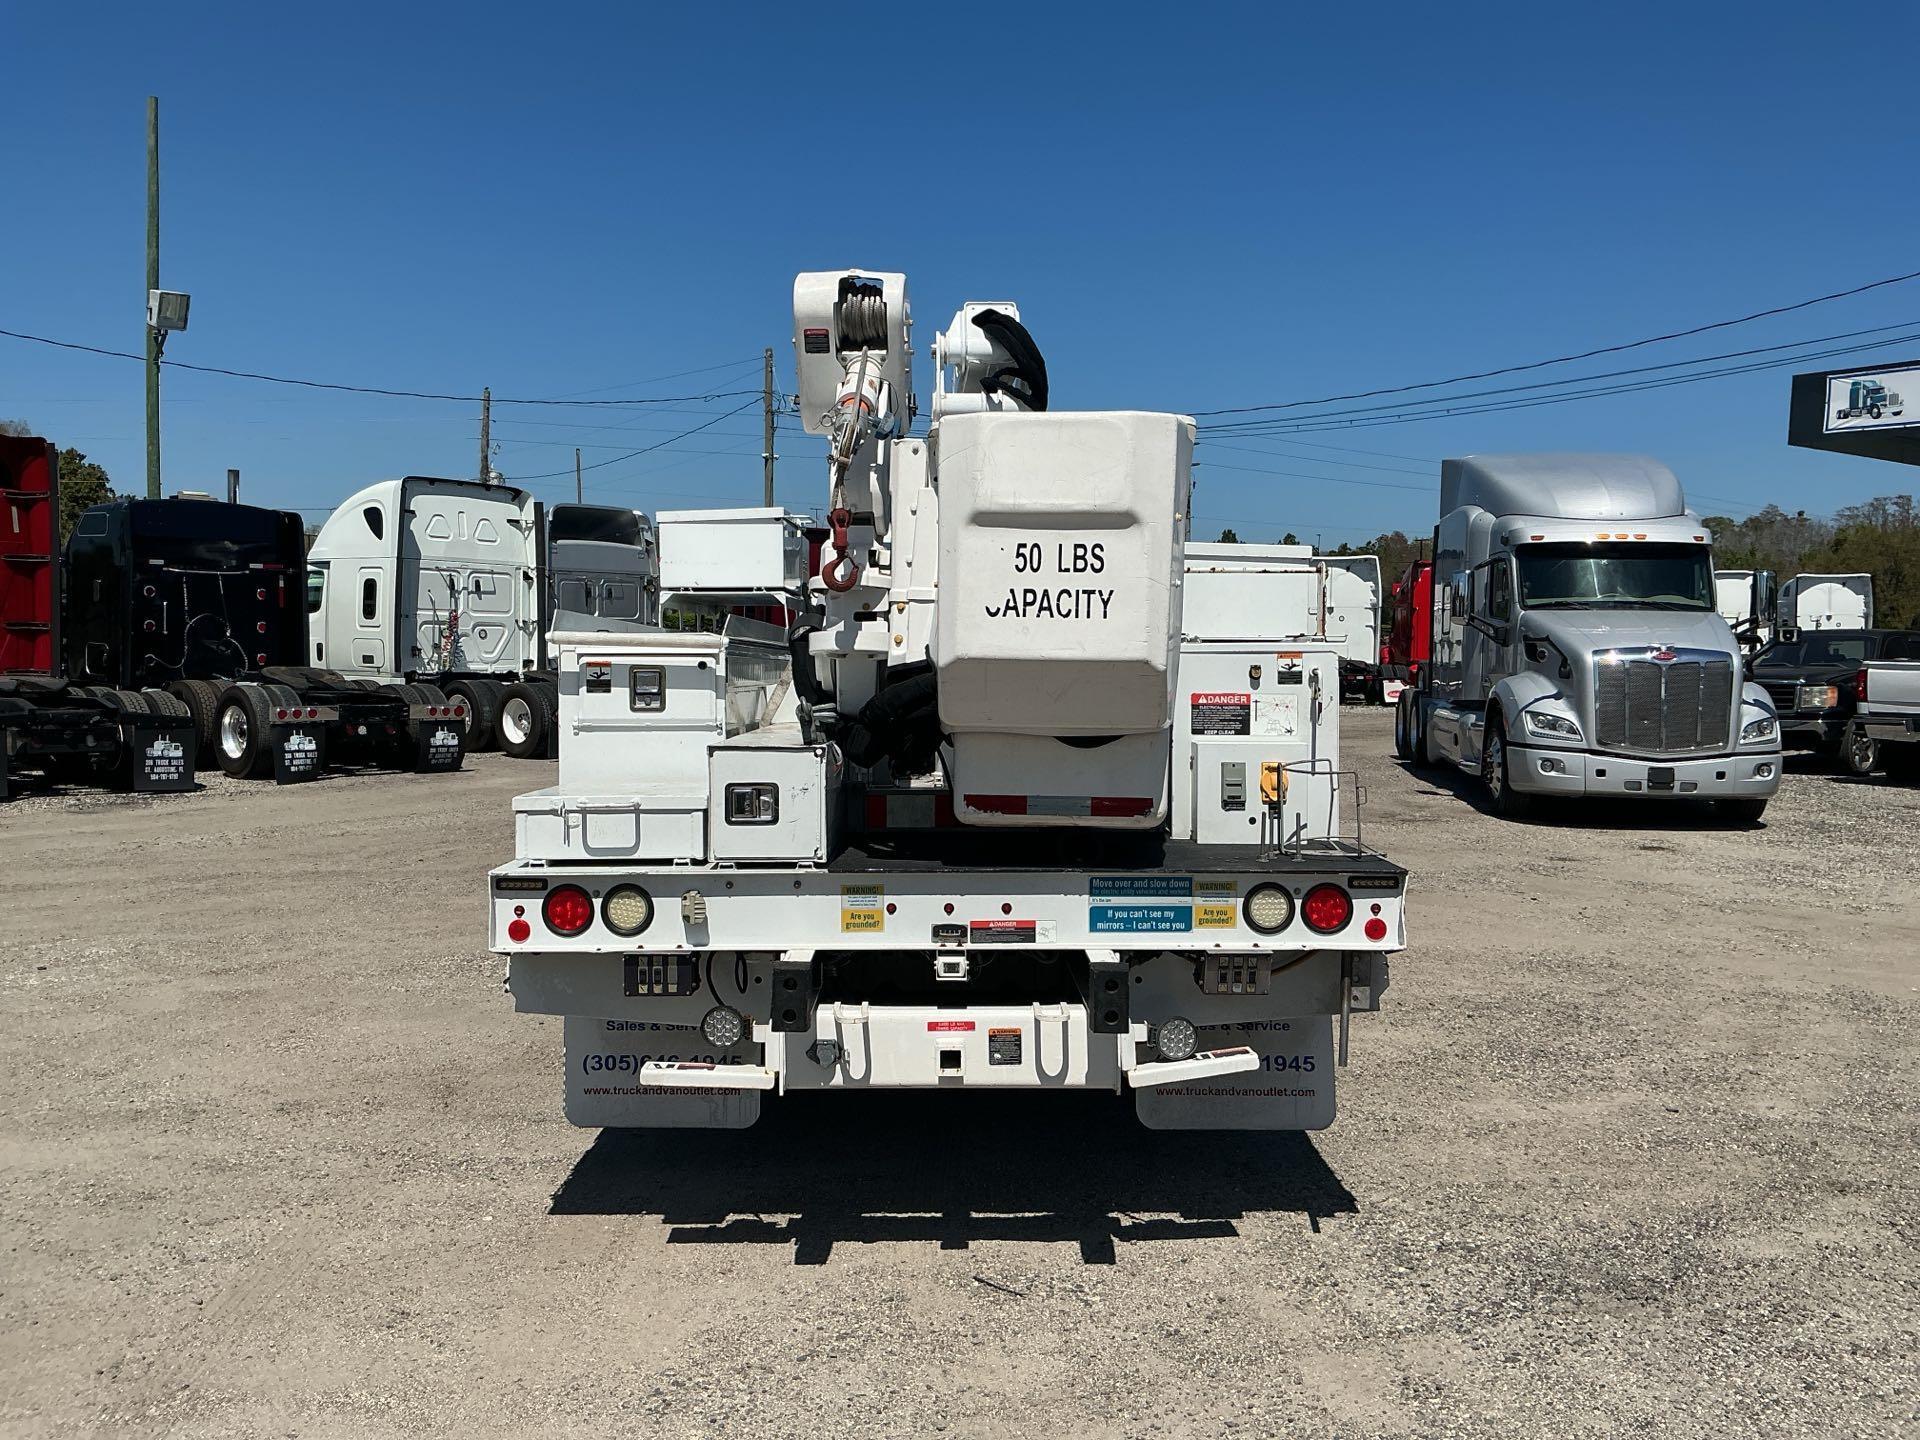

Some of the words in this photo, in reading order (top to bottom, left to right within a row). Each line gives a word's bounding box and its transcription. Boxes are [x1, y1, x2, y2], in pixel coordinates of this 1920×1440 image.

[1058, 543, 1105, 573] LBS
[1207, 695, 1247, 704] DANGER
[1092, 878, 1113, 888] Move
[1114, 879, 1131, 888] over
[1133, 878, 1148, 888] and
[1150, 878, 1168, 888] slow
[1169, 878, 1190, 888] down
[1120, 888, 1135, 896] utility
[850, 912, 862, 920] Are
[863, 913, 875, 921] you
[1107, 909, 1113, 917] If
[1114, 911, 1128, 919] you
[1129, 909, 1148, 917] can't
[1163, 911, 1175, 919] my
[845, 920, 880, 930] grounded?
[1097, 921, 1124, 929] mirrors
[1137, 921, 1156, 929] can't
[1171, 922, 1185, 930] you
[1198, 916, 1233, 925] grounded?
[606, 1020, 646, 1031] Sales
[650, 1022, 661, 1031] &
[1236, 1020, 1290, 1031] Service
[583, 1086, 741, 1096] www.truckandvanoutlet.com
[1156, 1086, 1315, 1097] www.truckandvanoutlet.com
